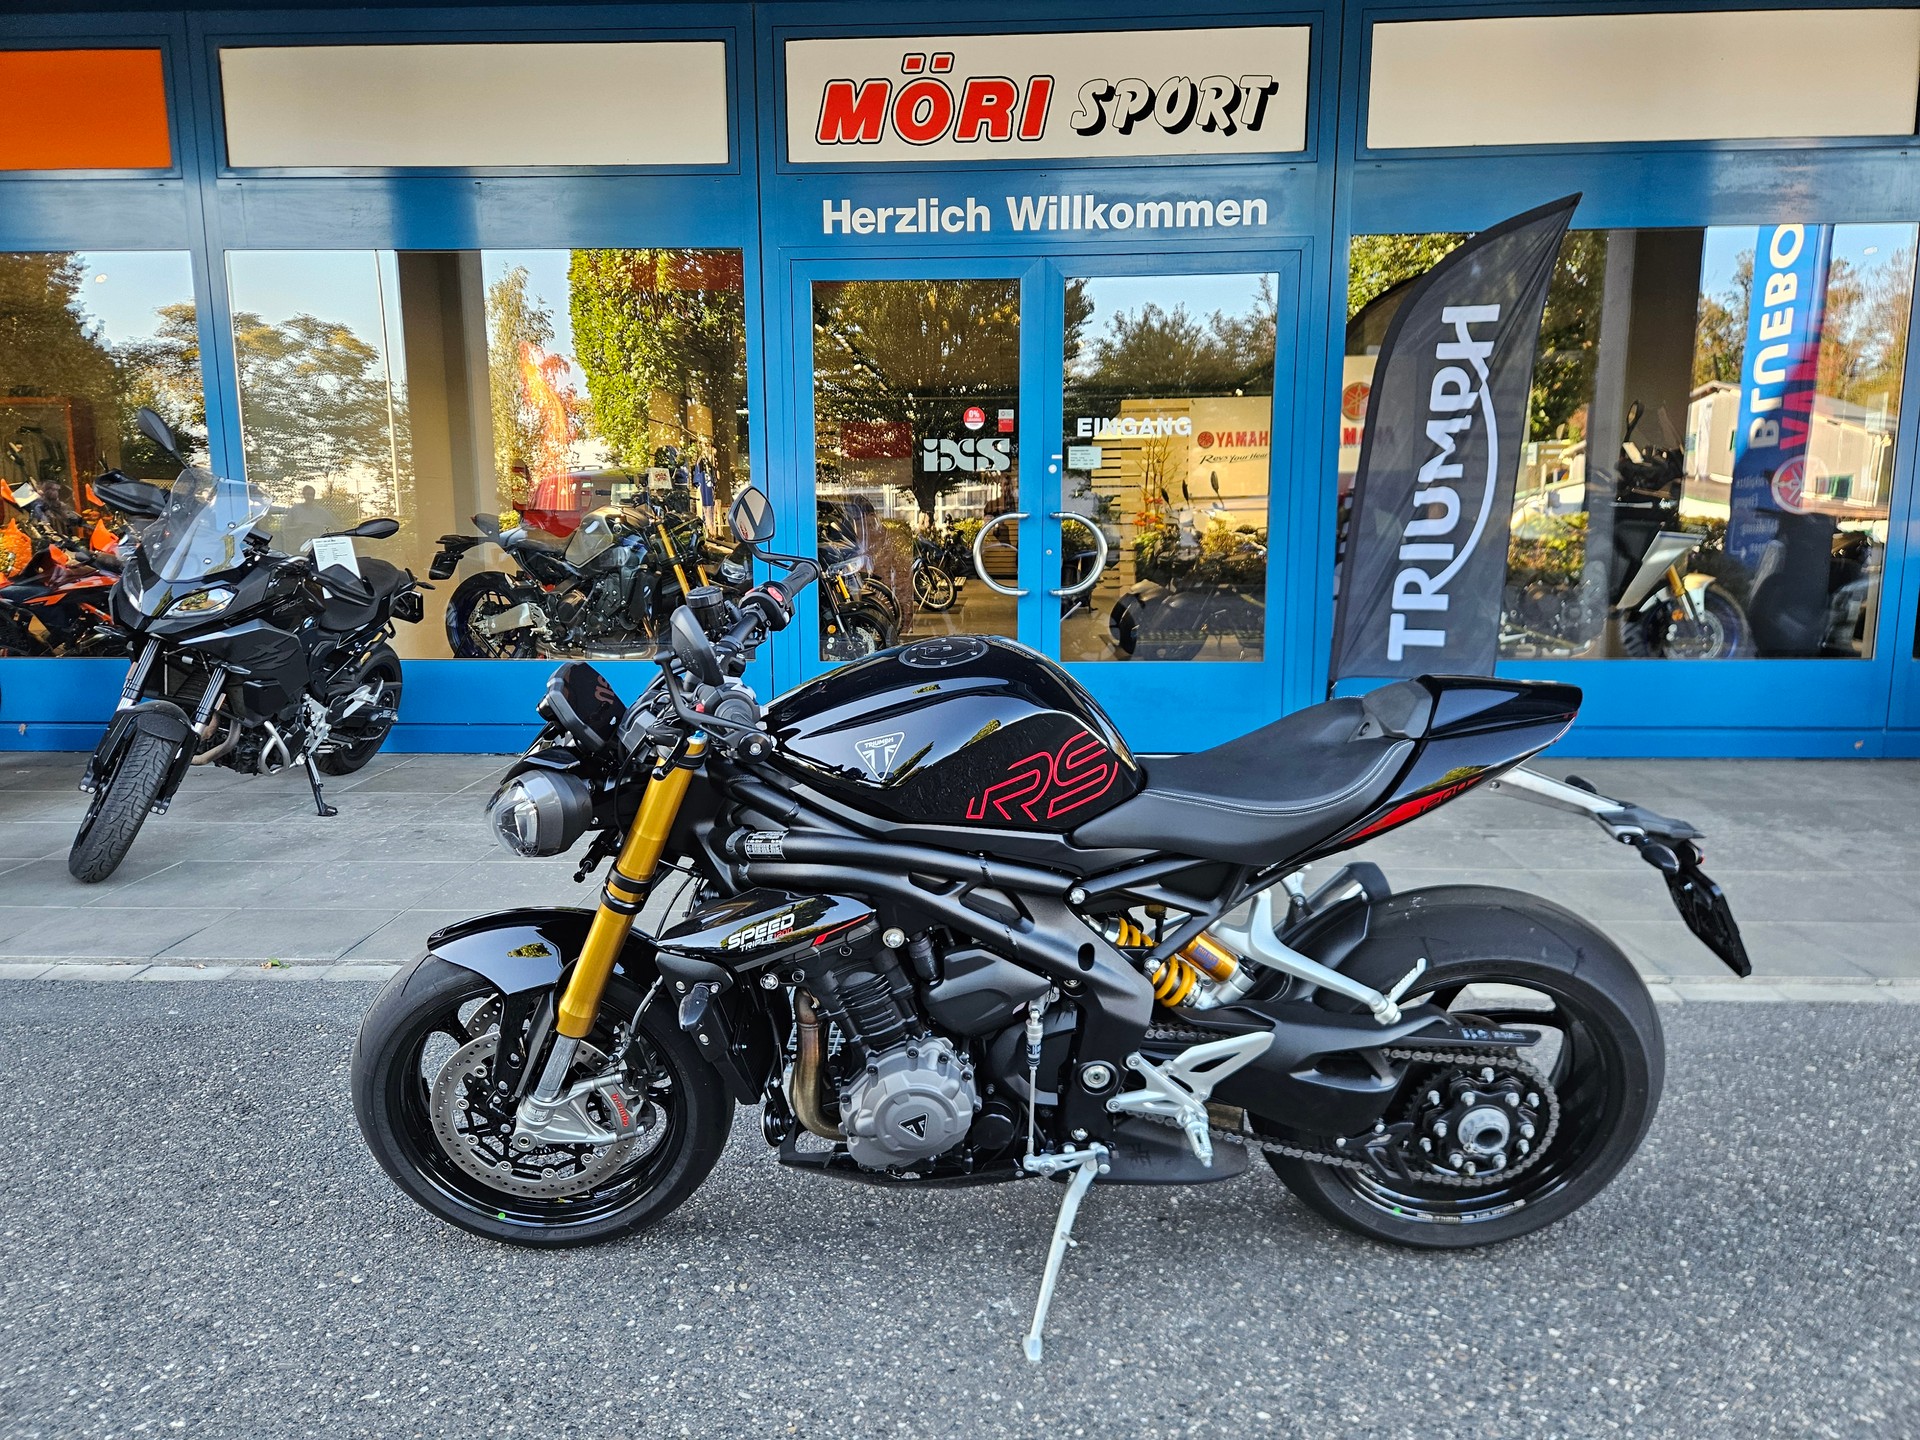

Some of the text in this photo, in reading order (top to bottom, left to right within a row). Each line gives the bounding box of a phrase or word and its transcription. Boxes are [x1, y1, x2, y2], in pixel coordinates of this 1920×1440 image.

[815, 52, 1279, 146] MÖRI SPORT
[822, 194, 1268, 235] Herzlich Willkommen
[1077, 416, 1192, 437] EINGANG
[1387, 304, 1501, 661] TRIUMPH
[864, 736, 894, 749] TRIUMPH
[965, 730, 1119, 822] RS
[727, 913, 795, 950] SPEED
[740, 933, 776, 953] TRIPLE
[610, 1093, 629, 1128] brembo
